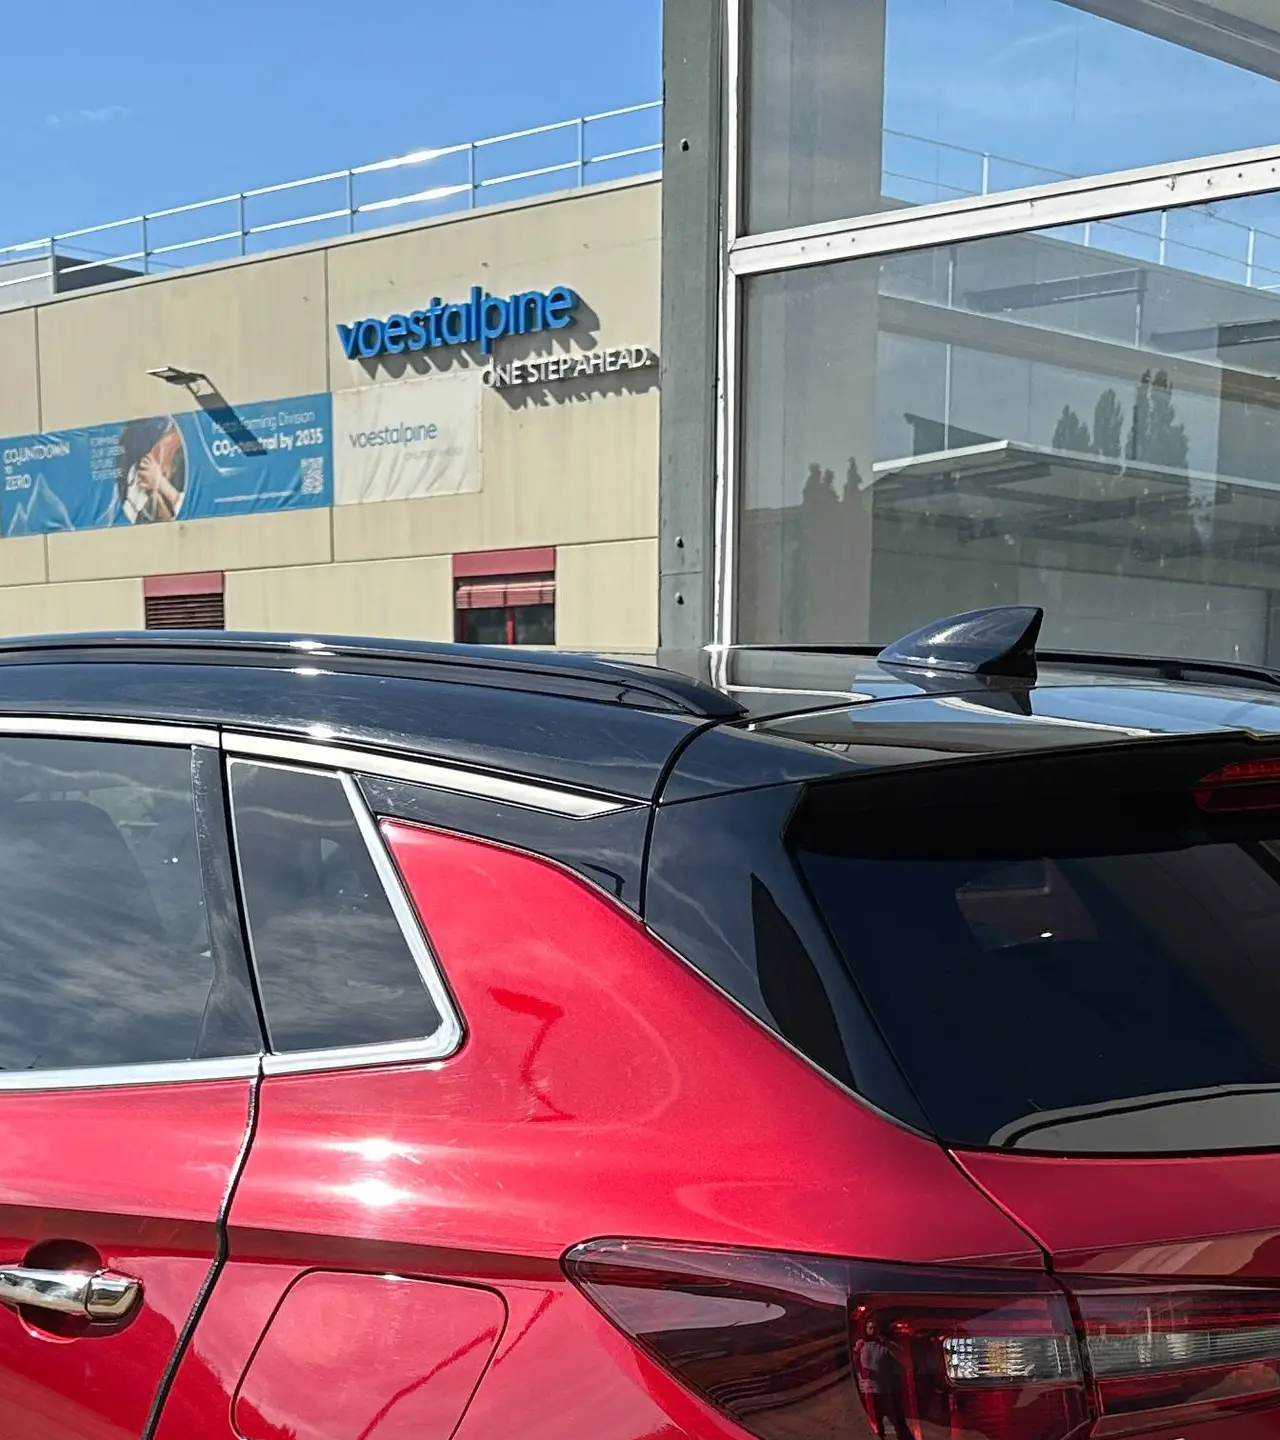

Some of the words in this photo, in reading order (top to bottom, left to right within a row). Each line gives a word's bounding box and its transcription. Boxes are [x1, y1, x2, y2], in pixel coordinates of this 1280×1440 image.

[336, 286, 578, 360] voestalpine
[480, 363, 522, 389] ONE
[526, 359, 572, 383] STEP
[572, 347, 652, 378] AHEAD.
[280, 431, 294, 451] by
[295, 427, 325, 447] 2035
[349, 421, 439, 449] voestalpine
[5, 474, 32, 491] ZERO
